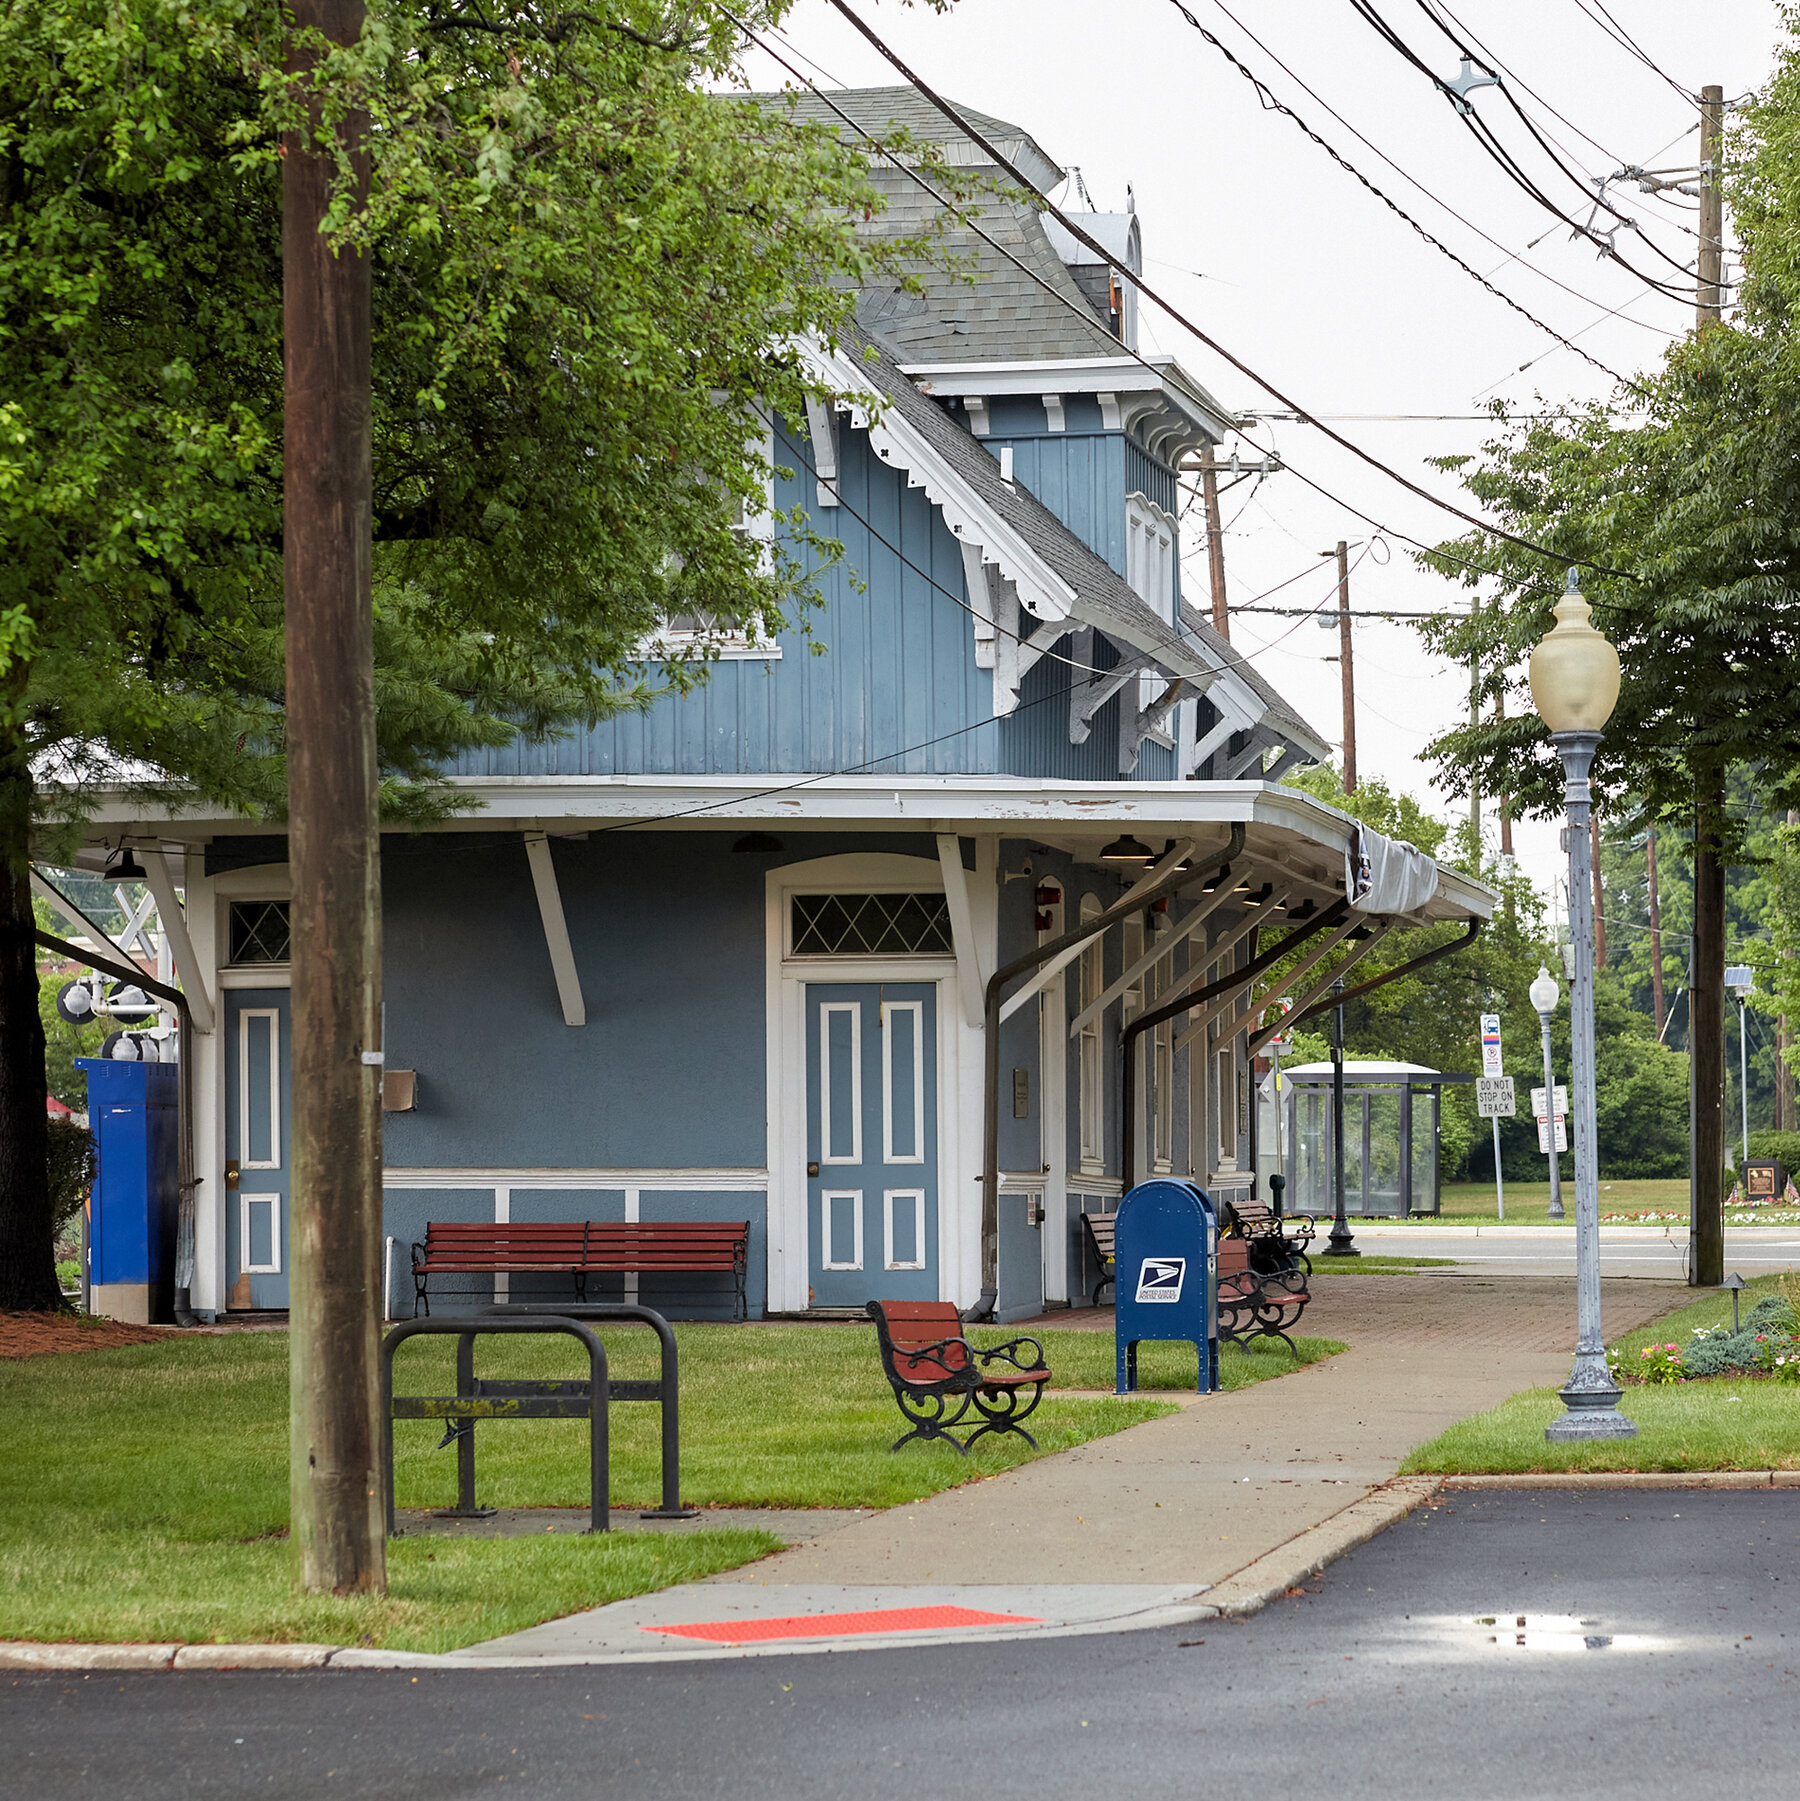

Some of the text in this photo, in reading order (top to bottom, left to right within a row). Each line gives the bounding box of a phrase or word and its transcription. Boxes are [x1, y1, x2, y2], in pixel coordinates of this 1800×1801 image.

[1480, 1079, 1509, 1091] DO NOT
[1479, 1090, 1513, 1102] STOP ON
[1483, 1103, 1510, 1114] TRACK
